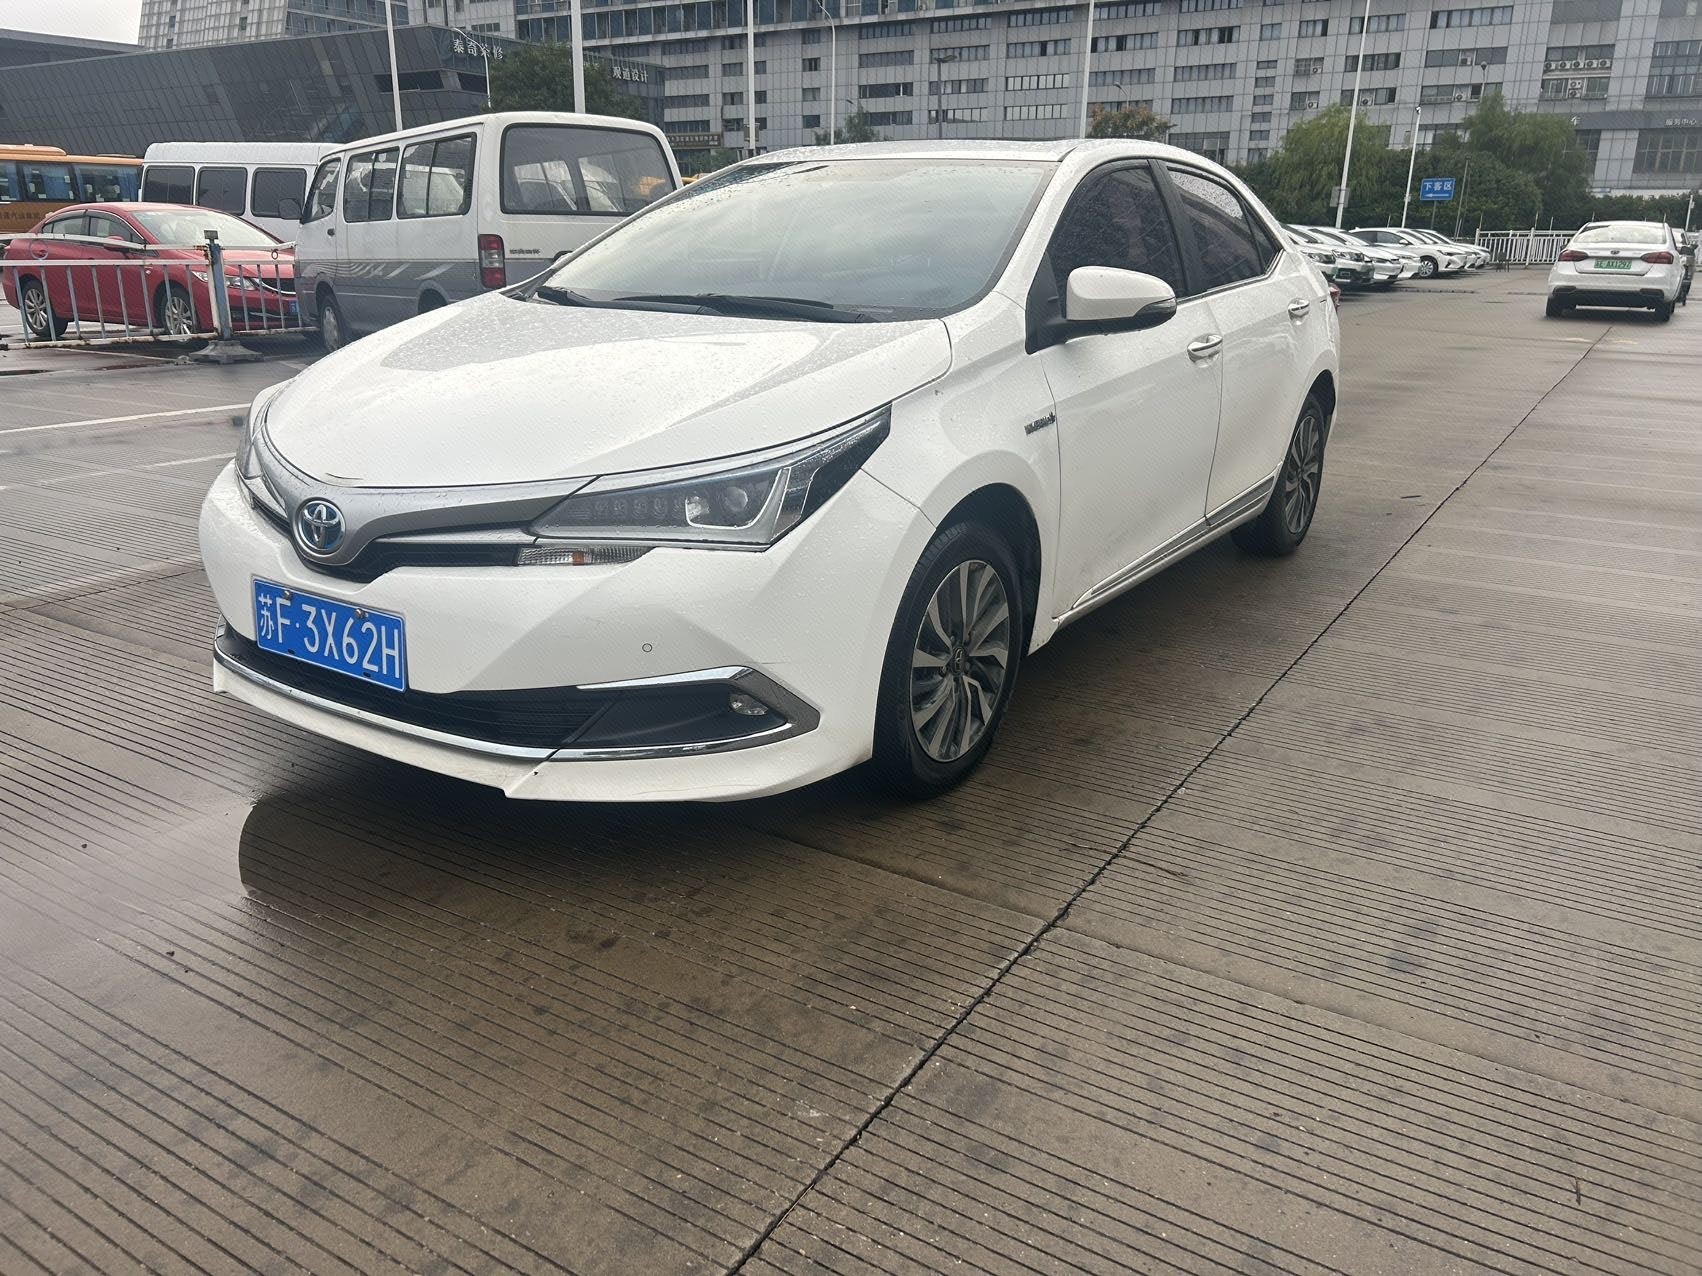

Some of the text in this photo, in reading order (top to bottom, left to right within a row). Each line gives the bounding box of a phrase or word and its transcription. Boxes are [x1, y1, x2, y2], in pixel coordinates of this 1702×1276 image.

[1423, 181, 1452, 191] 下客区
[258, 593, 400, 679] 苏F·3X62H
